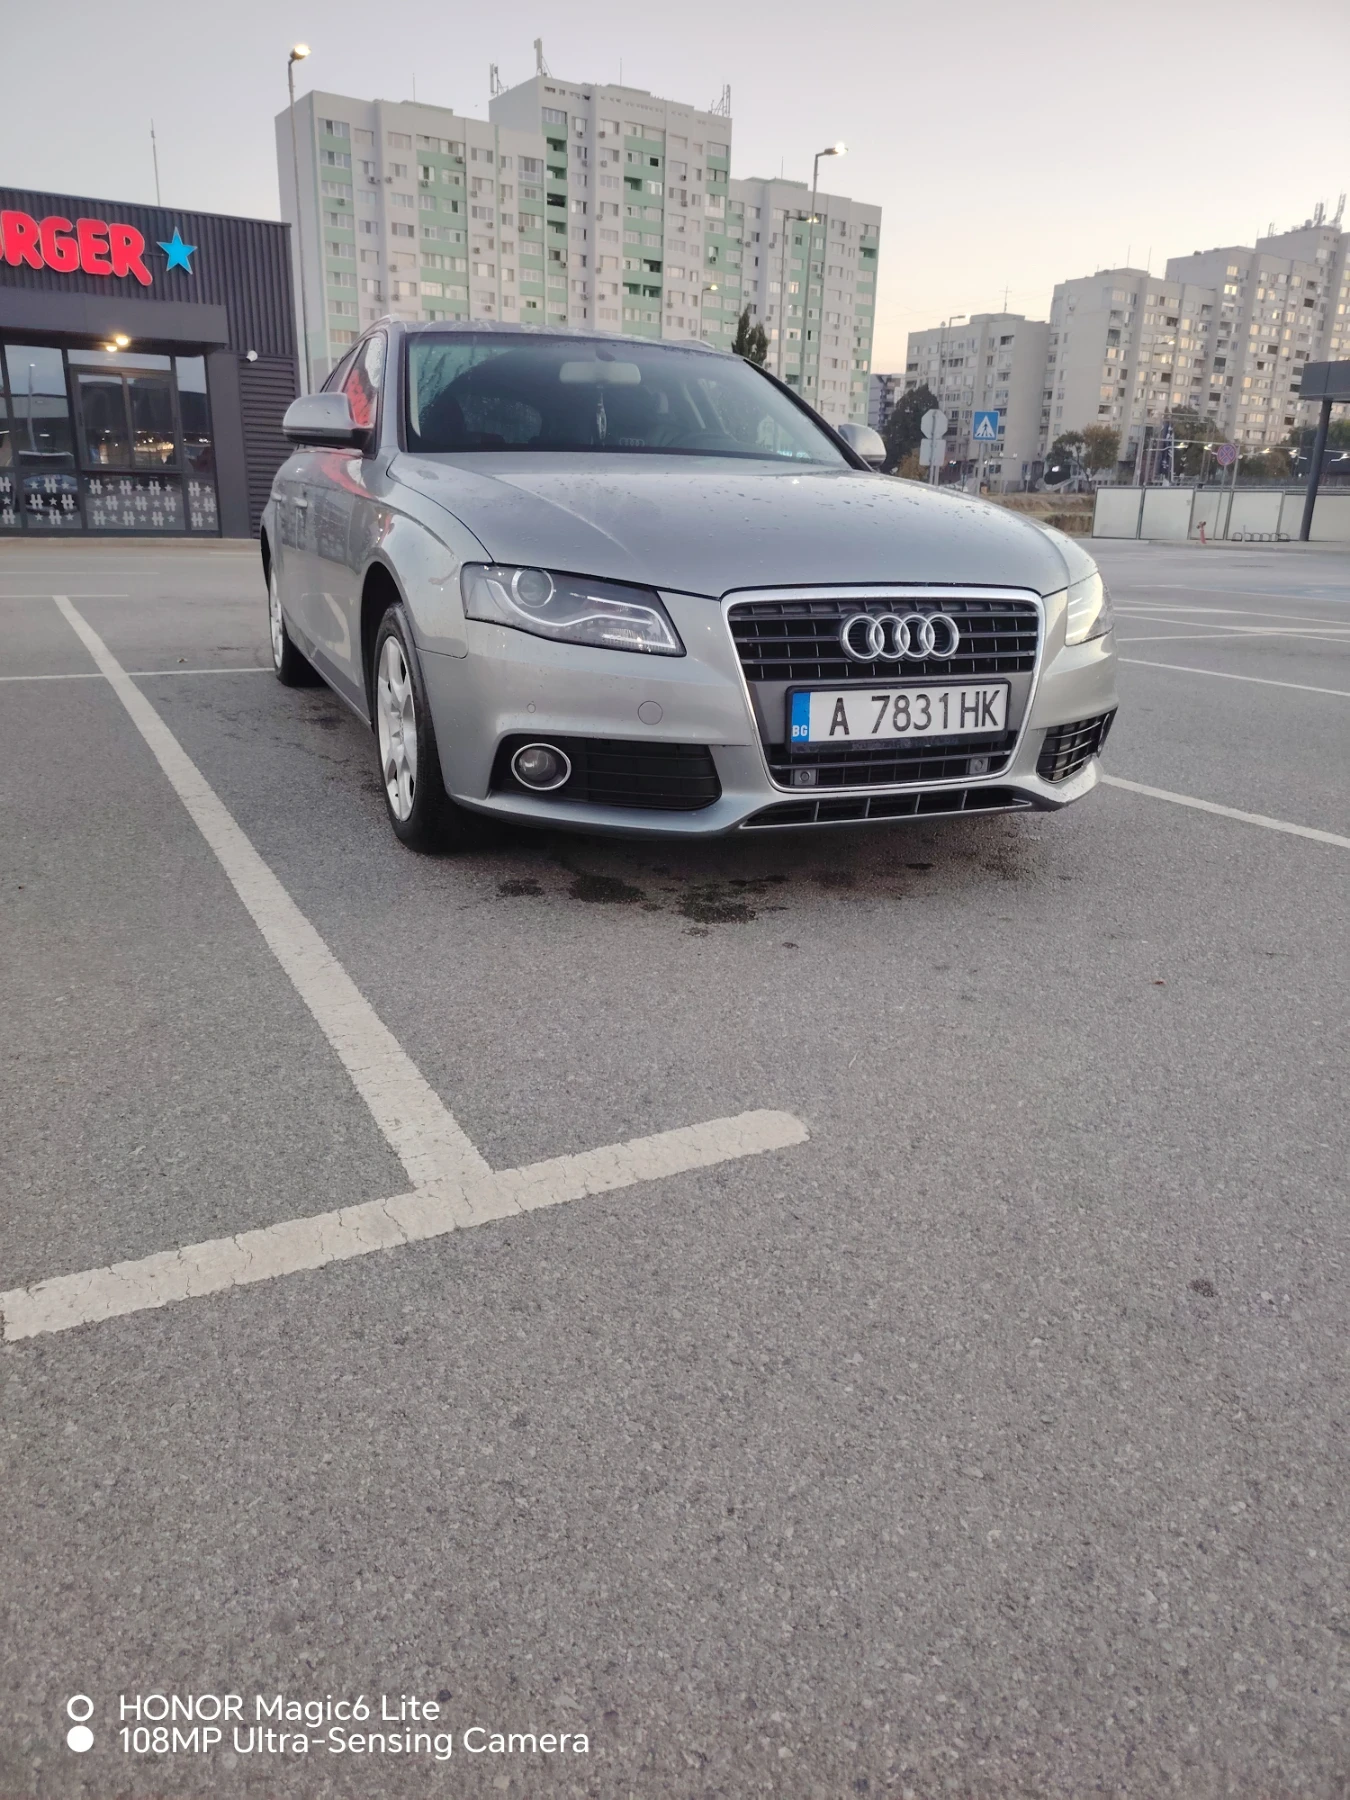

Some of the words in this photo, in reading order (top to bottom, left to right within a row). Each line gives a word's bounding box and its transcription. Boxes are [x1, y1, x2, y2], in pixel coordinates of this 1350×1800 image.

[0, 210, 153, 286] RGER
[791, 724, 808, 737] BG
[829, 697, 850, 736] A
